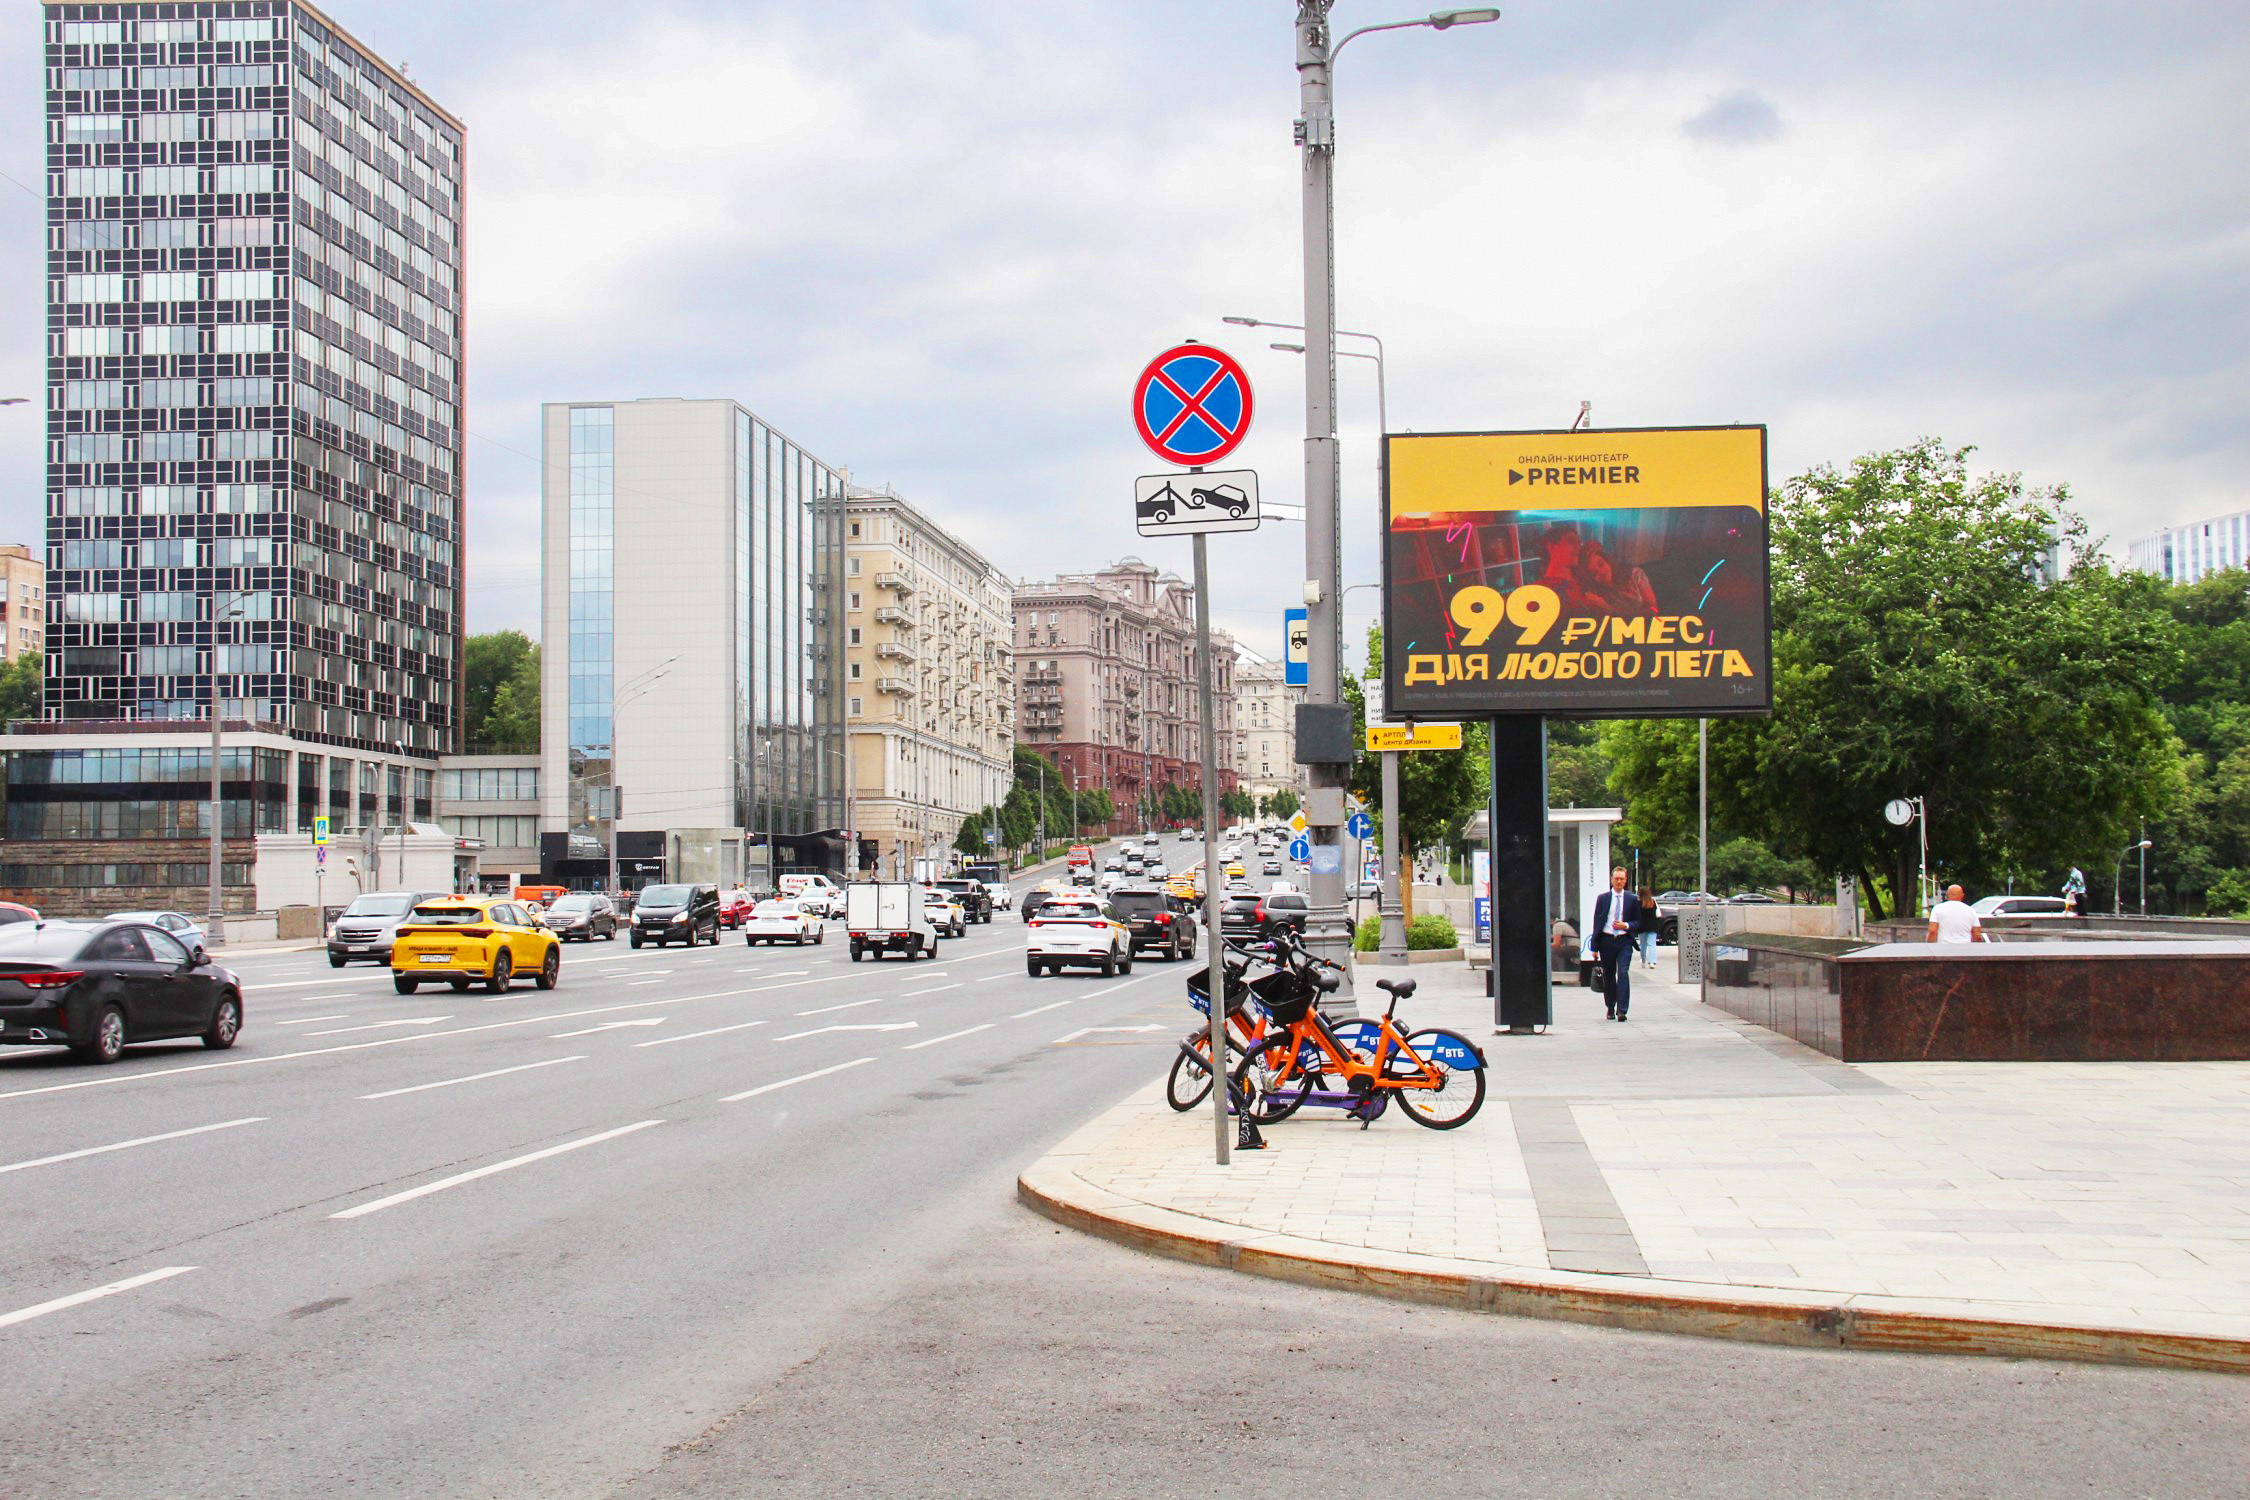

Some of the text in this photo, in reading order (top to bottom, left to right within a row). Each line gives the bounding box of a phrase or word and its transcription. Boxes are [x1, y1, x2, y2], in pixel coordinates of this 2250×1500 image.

[1518, 453, 1630, 464] ОНЛАЙН-КИНОТЕАТР
[1528, 466, 1640, 486] PREMIER
[1450, 585, 1705, 647] 99 ₽/МЕС
[1404, 649, 1754, 687] ДЛЯ ЛЮБОГО ЛЕТА
[1730, 684, 1753, 695] 16+
[1369, 1036, 1381, 1046] ВТ
[1445, 1048, 1465, 1058] ВТБ
